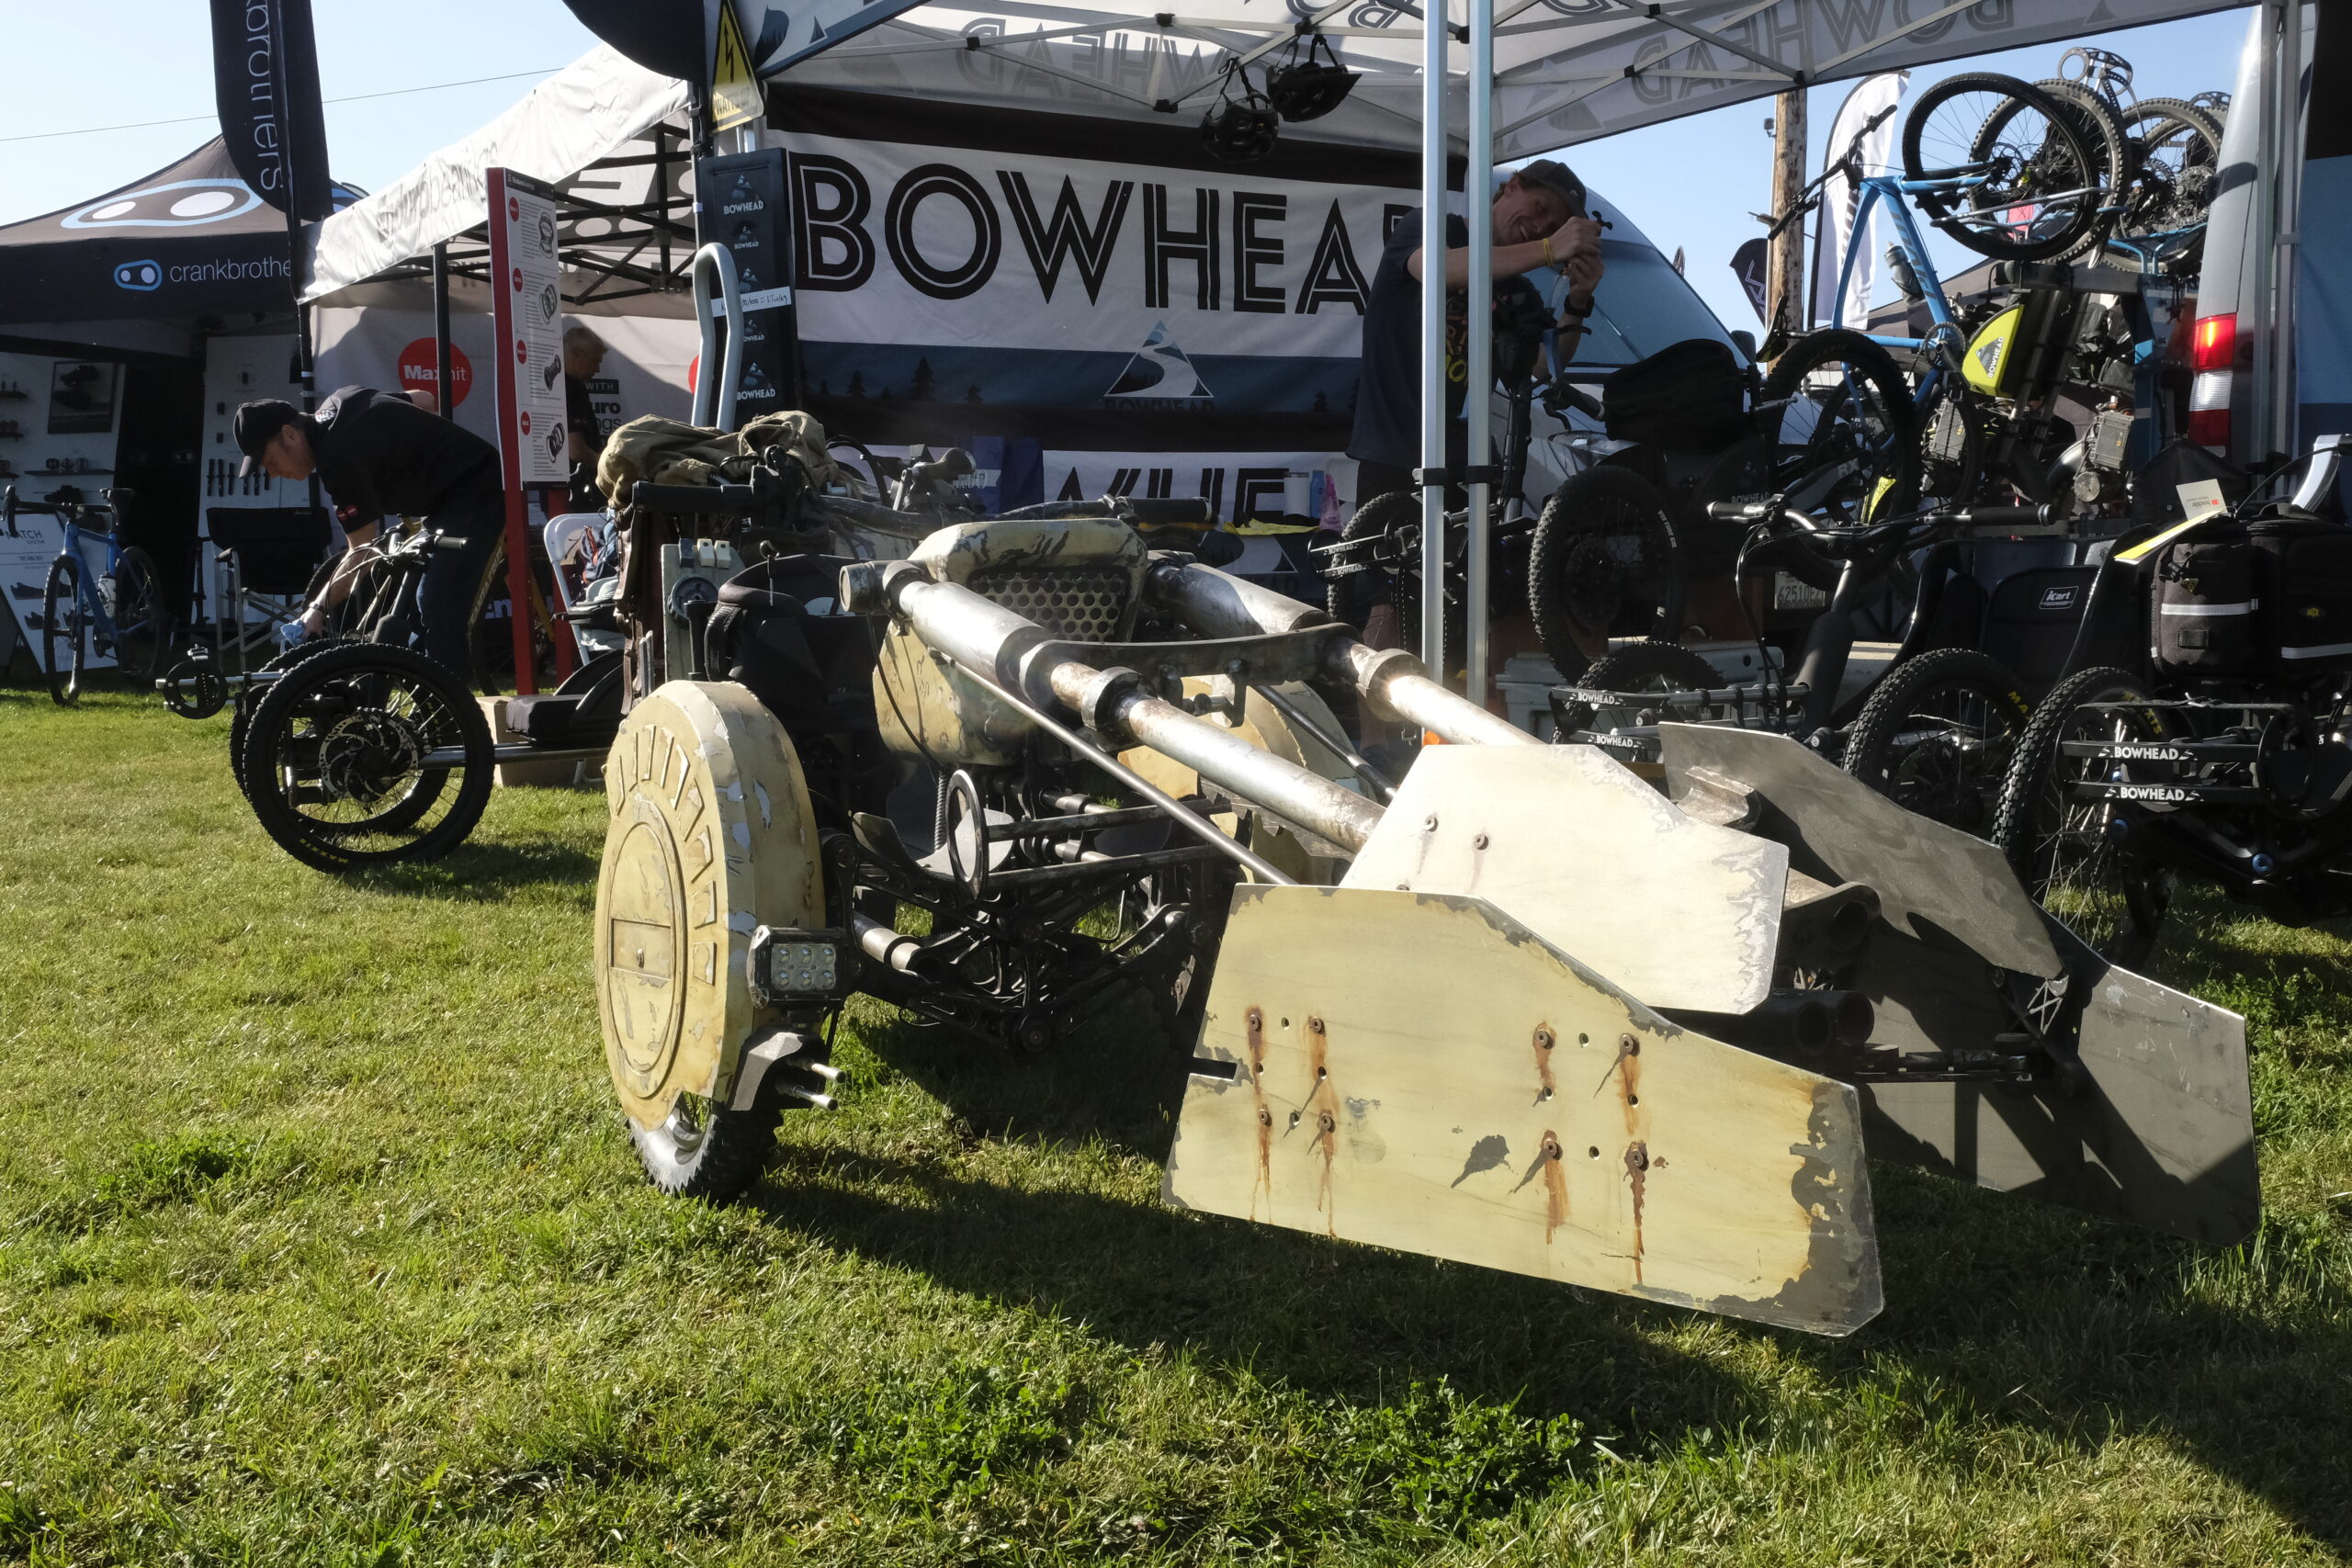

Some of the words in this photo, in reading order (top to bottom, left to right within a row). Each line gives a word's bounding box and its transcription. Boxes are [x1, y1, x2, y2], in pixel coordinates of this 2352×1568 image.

[245, 0, 284, 191] broers
[723, 200, 764, 215] BOWHEAD
[734, 241, 759, 250] BOWHEAD
[169, 256, 291, 283] crankbrothe
[743, 334, 765, 343] OWHEAD
[1986, 336, 2004, 378] BOWHEAD
[403, 365, 467, 381] Mait
[737, 388, 776, 401] BOWHEAD
[5, 529, 44, 540] MTCH
[1577, 692, 1615, 705] BOWHEAD
[1596, 735, 1634, 748] BOWHEAD
[2114, 746, 2179, 761] BOWHEAD
[2120, 786, 2185, 801] BOWHEAD
